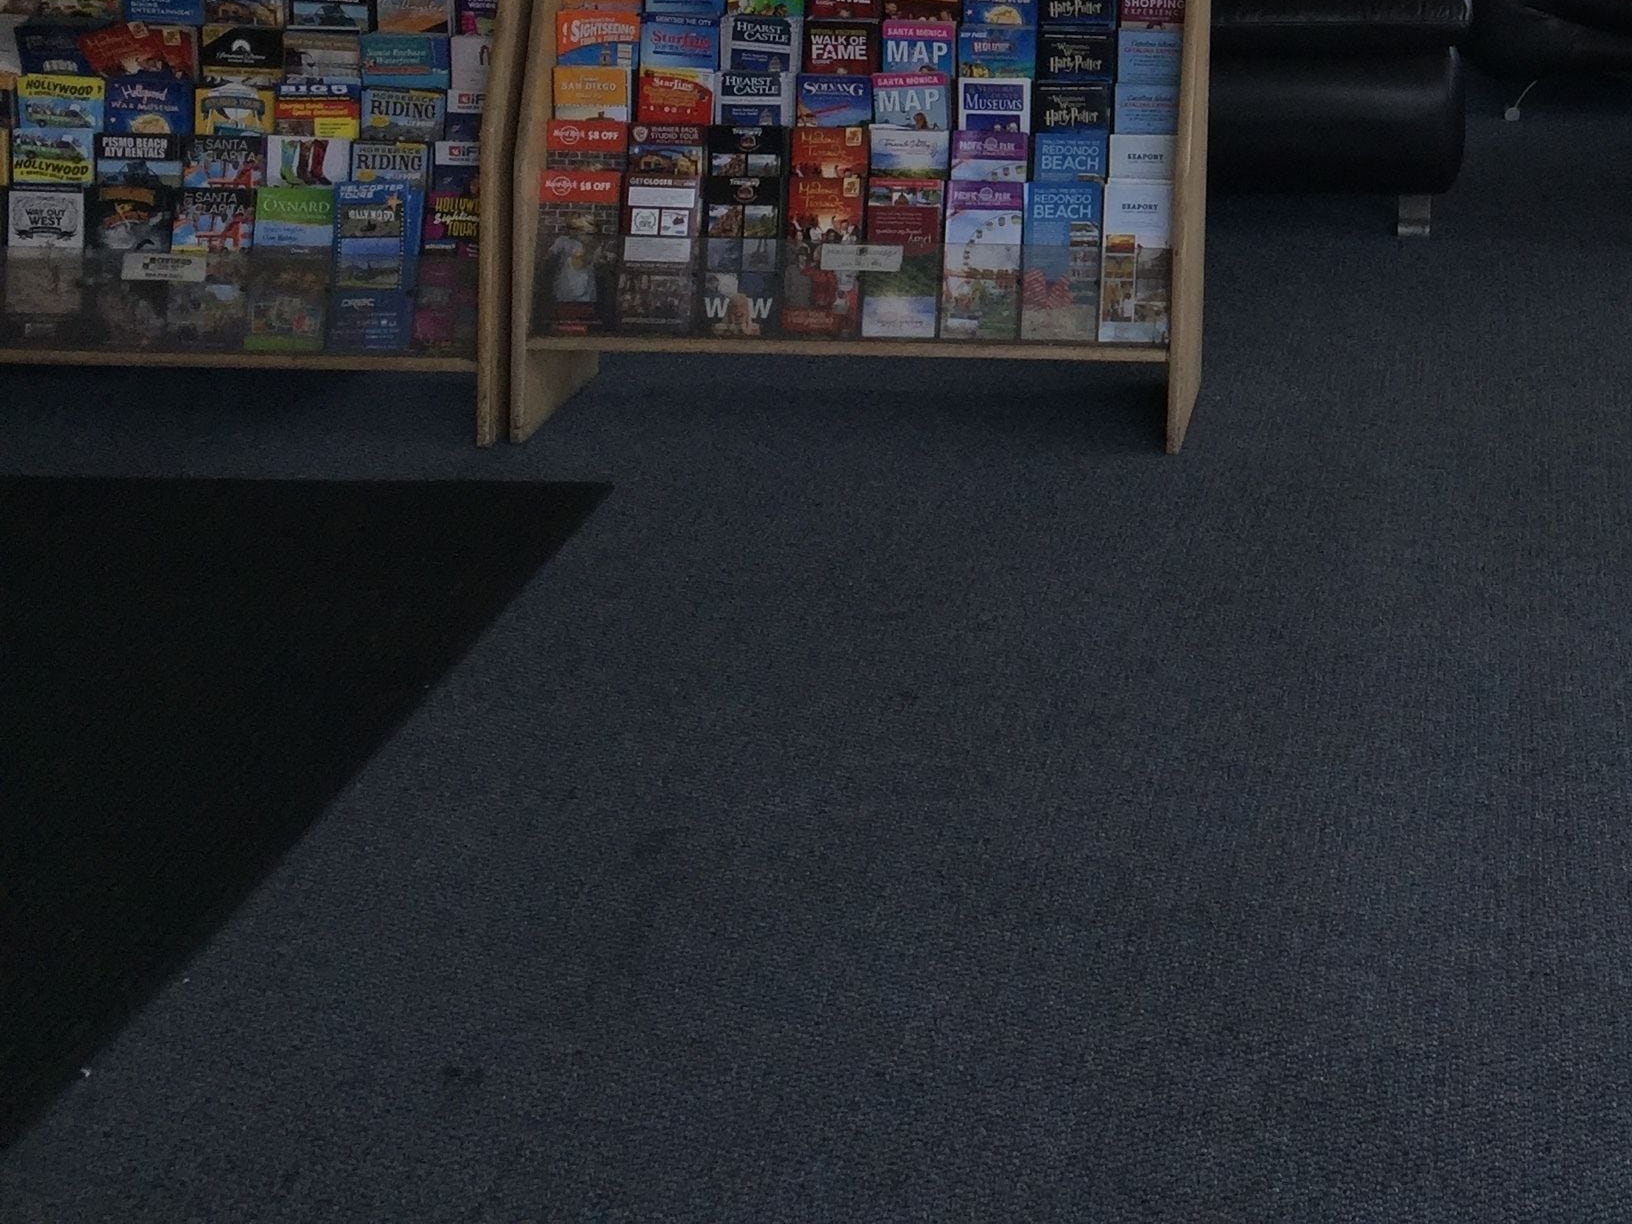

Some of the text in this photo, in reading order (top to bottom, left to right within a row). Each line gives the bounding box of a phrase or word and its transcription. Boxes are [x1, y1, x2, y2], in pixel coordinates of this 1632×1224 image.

[1048, 0, 1103, 19] Harry Potter
[571, 20, 636, 43] SIGHTSEEING
[736, 21, 783, 34] HEARST
[887, 27, 949, 37] SANTA MONICA
[743, 30, 789, 44] CASTLE
[810, 34, 868, 47] WALK OF
[811, 44, 868, 62] FAME
[886, 39, 949, 64] MAP
[1049, 55, 1103, 74] Harry Potter
[25, 79, 94, 96] HOLLYWOOD
[561, 81, 617, 92] SAN DIEGO
[725, 76, 773, 88] HEARST
[877, 76, 940, 86] SANTA MONICA
[733, 83, 780, 96] CASTLE
[802, 81, 864, 97] SOLVANG
[876, 88, 940, 113] MAP
[965, 93, 1024, 112] MUSEUMS
[136, 103, 180, 113] MUSEUM
[369, 100, 436, 118] RIDING
[1044, 106, 1099, 128] Harry Potter
[587, 129, 601, 141] $8
[601, 130, 620, 141] OFF
[650, 132, 699, 141] STUDIO TOUR
[101, 136, 168, 150] PISMO BEACH
[205, 138, 248, 150] SANTA
[1041, 144, 1099, 155] REDONDO
[104, 147, 166, 159] ATV RENTALS
[1127, 153, 1164, 161] SEAPORT
[14, 158, 90, 176] HOLLYWOOD
[355, 154, 422, 173] RIDING
[1041, 155, 1099, 171] BEACH
[580, 179, 613, 191] $8 OFF
[195, 192, 238, 203] SANTA
[1034, 194, 1093, 205] REDONDO
[262, 198, 331, 214] OXNARD
[1033, 204, 1093, 219] BEACH
[1121, 203, 1159, 211] SEAPORT
[46, 208, 67, 218] OUT
[29, 216, 63, 227] WEST
